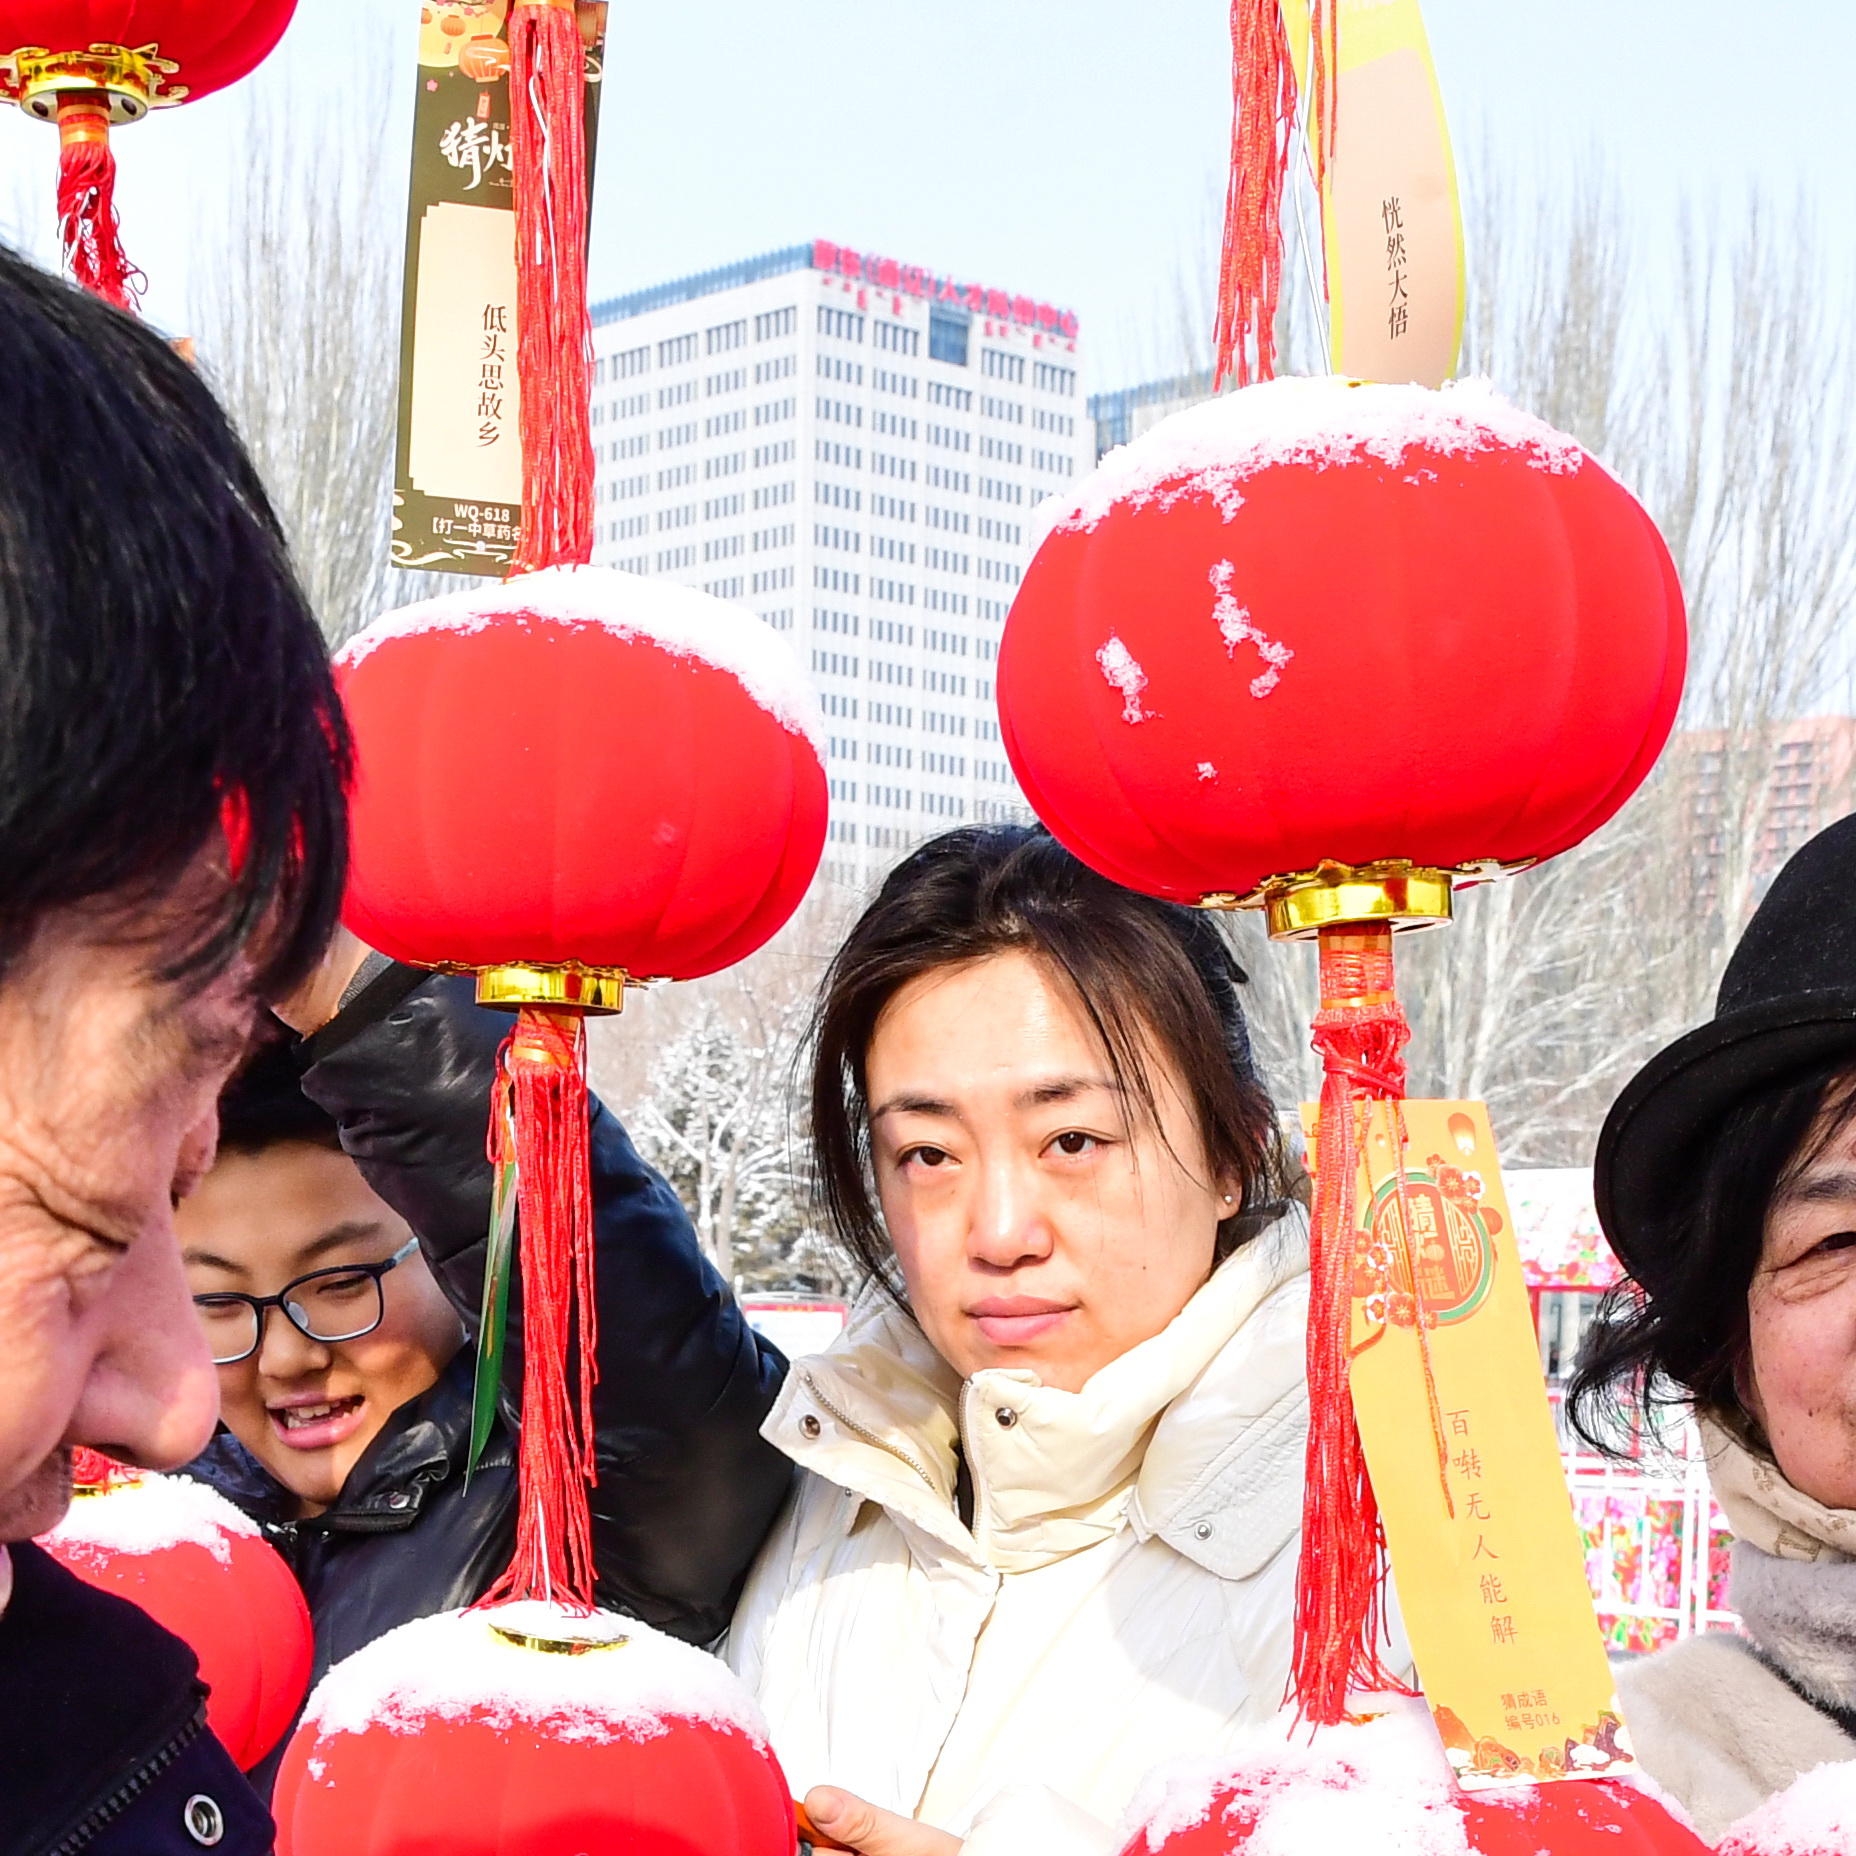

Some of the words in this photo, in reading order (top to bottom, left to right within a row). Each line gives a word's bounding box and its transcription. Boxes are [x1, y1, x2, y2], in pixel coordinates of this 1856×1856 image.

[1381, 195, 1408, 340] 恍然大悟
[477, 302, 508, 448] 低头思故乡
[454, 503, 511, 523] WQ-618
[1446, 1408, 1519, 1647] 百啭无人能解
[1500, 1689, 1548, 1711] 猜成语
[1504, 1712, 1561, 1731] 编号016
